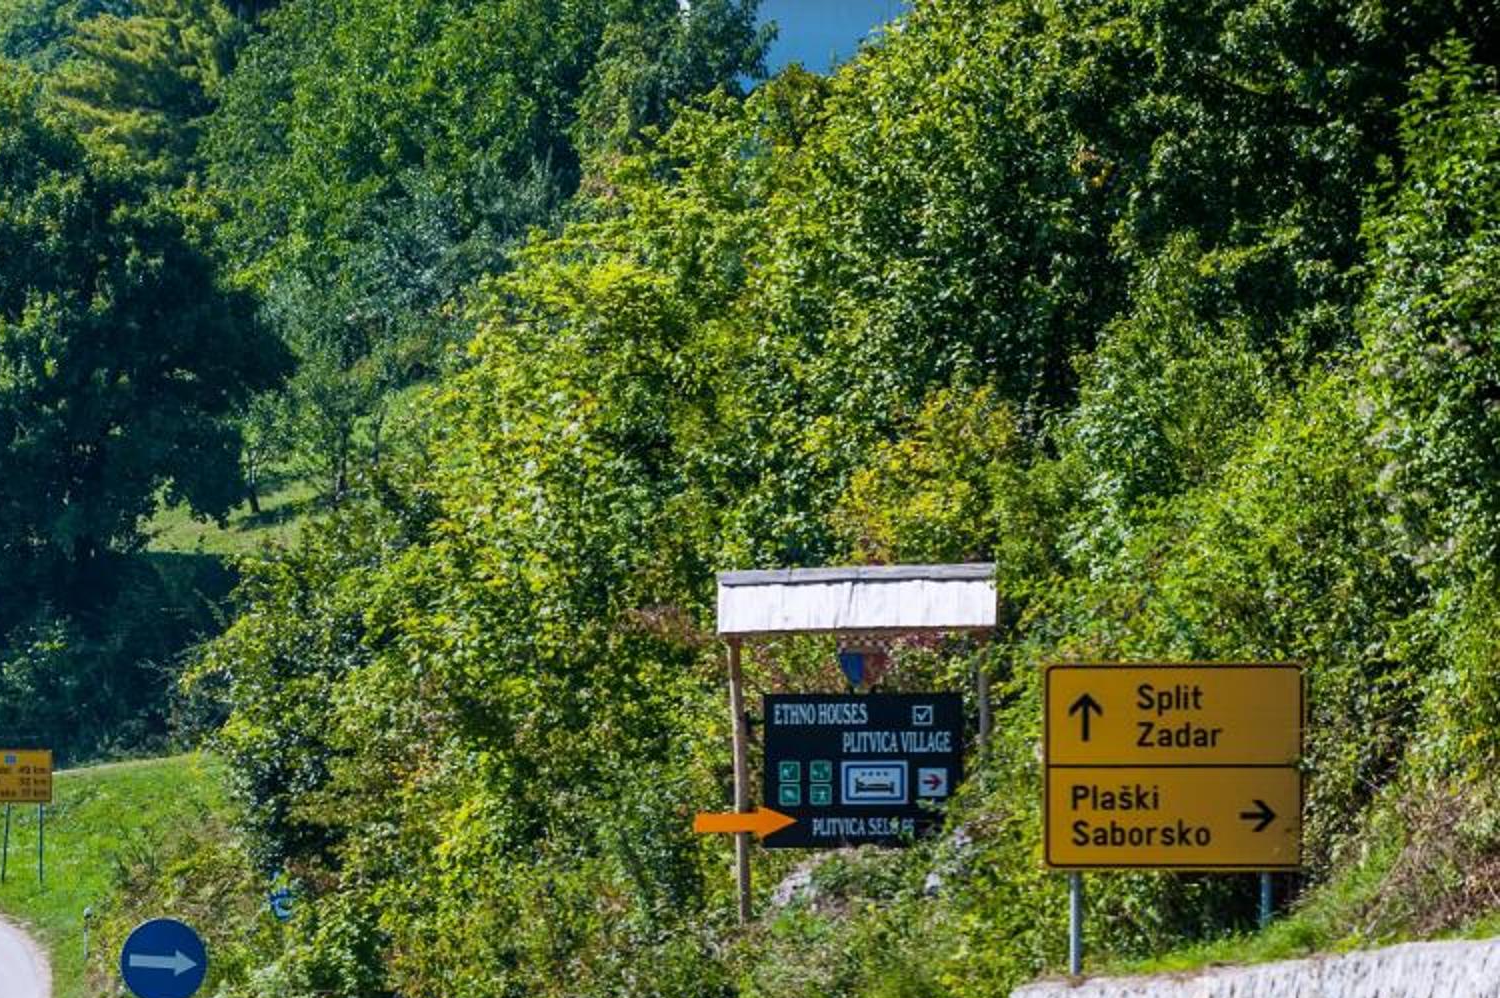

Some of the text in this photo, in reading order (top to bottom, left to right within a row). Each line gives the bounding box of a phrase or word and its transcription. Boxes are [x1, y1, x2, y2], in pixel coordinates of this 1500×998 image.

[1137, 684, 1204, 716] Split
[774, 703, 868, 725] ETHNO HOUSES
[842, 731, 952, 752] PLITVICA VILLAGE
[1136, 721, 1223, 748] Zadar
[1071, 784, 1160, 810] Plaški
[812, 818, 865, 836] PLITVICA
[1072, 820, 1211, 847] Saborsko
